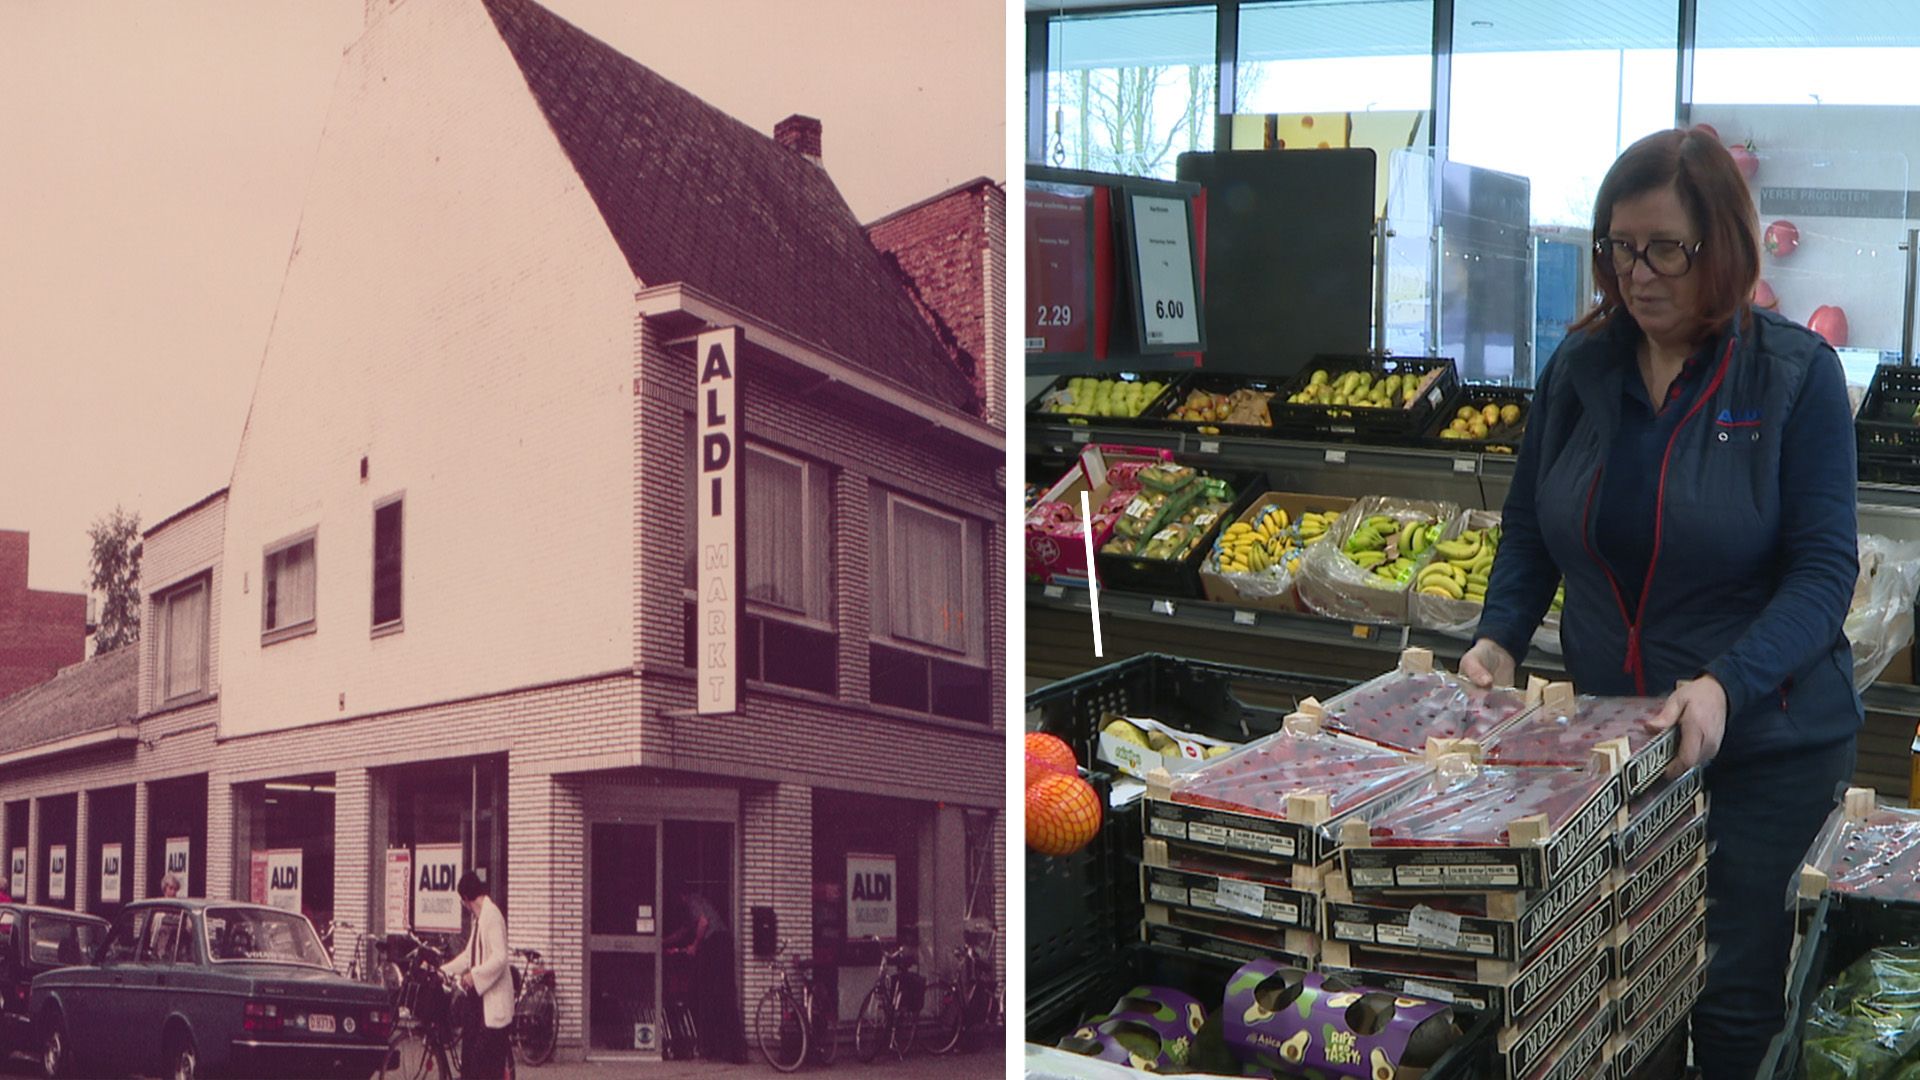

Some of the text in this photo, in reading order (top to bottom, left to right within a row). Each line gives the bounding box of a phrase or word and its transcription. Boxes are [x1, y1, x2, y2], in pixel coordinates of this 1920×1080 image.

[1761, 189, 1870, 202] VERSE PRODUCTEN
[1037, 305, 1072, 327] 2.29
[1155, 299, 1185, 320] 6.00
[701, 342, 733, 518] ALDI
[704, 542, 730, 703] MARKT
[1556, 785, 1616, 868] MOLINERO
[1632, 775, 1696, 850] MOLINERO
[168, 852, 187, 873] ALDI
[270, 866, 298, 890] ALDI
[418, 864, 456, 892] ALDI
[851, 872, 892, 902] ALDI
[1530, 852, 1604, 937] MOLINERO
[1628, 826, 1698, 906] MOLINERO
[1631, 876, 1700, 959] MOLINERO
[1523, 911, 1604, 1003] MOLINERO
[1631, 925, 1699, 1013] MOLINERO
[1331, 1031, 1357, 1047] RIPE
[1525, 963, 1601, 1063] MOLINERO
[1631, 975, 1700, 1065] MOLINERO
[1324, 1044, 1361, 1066] TASTY!
